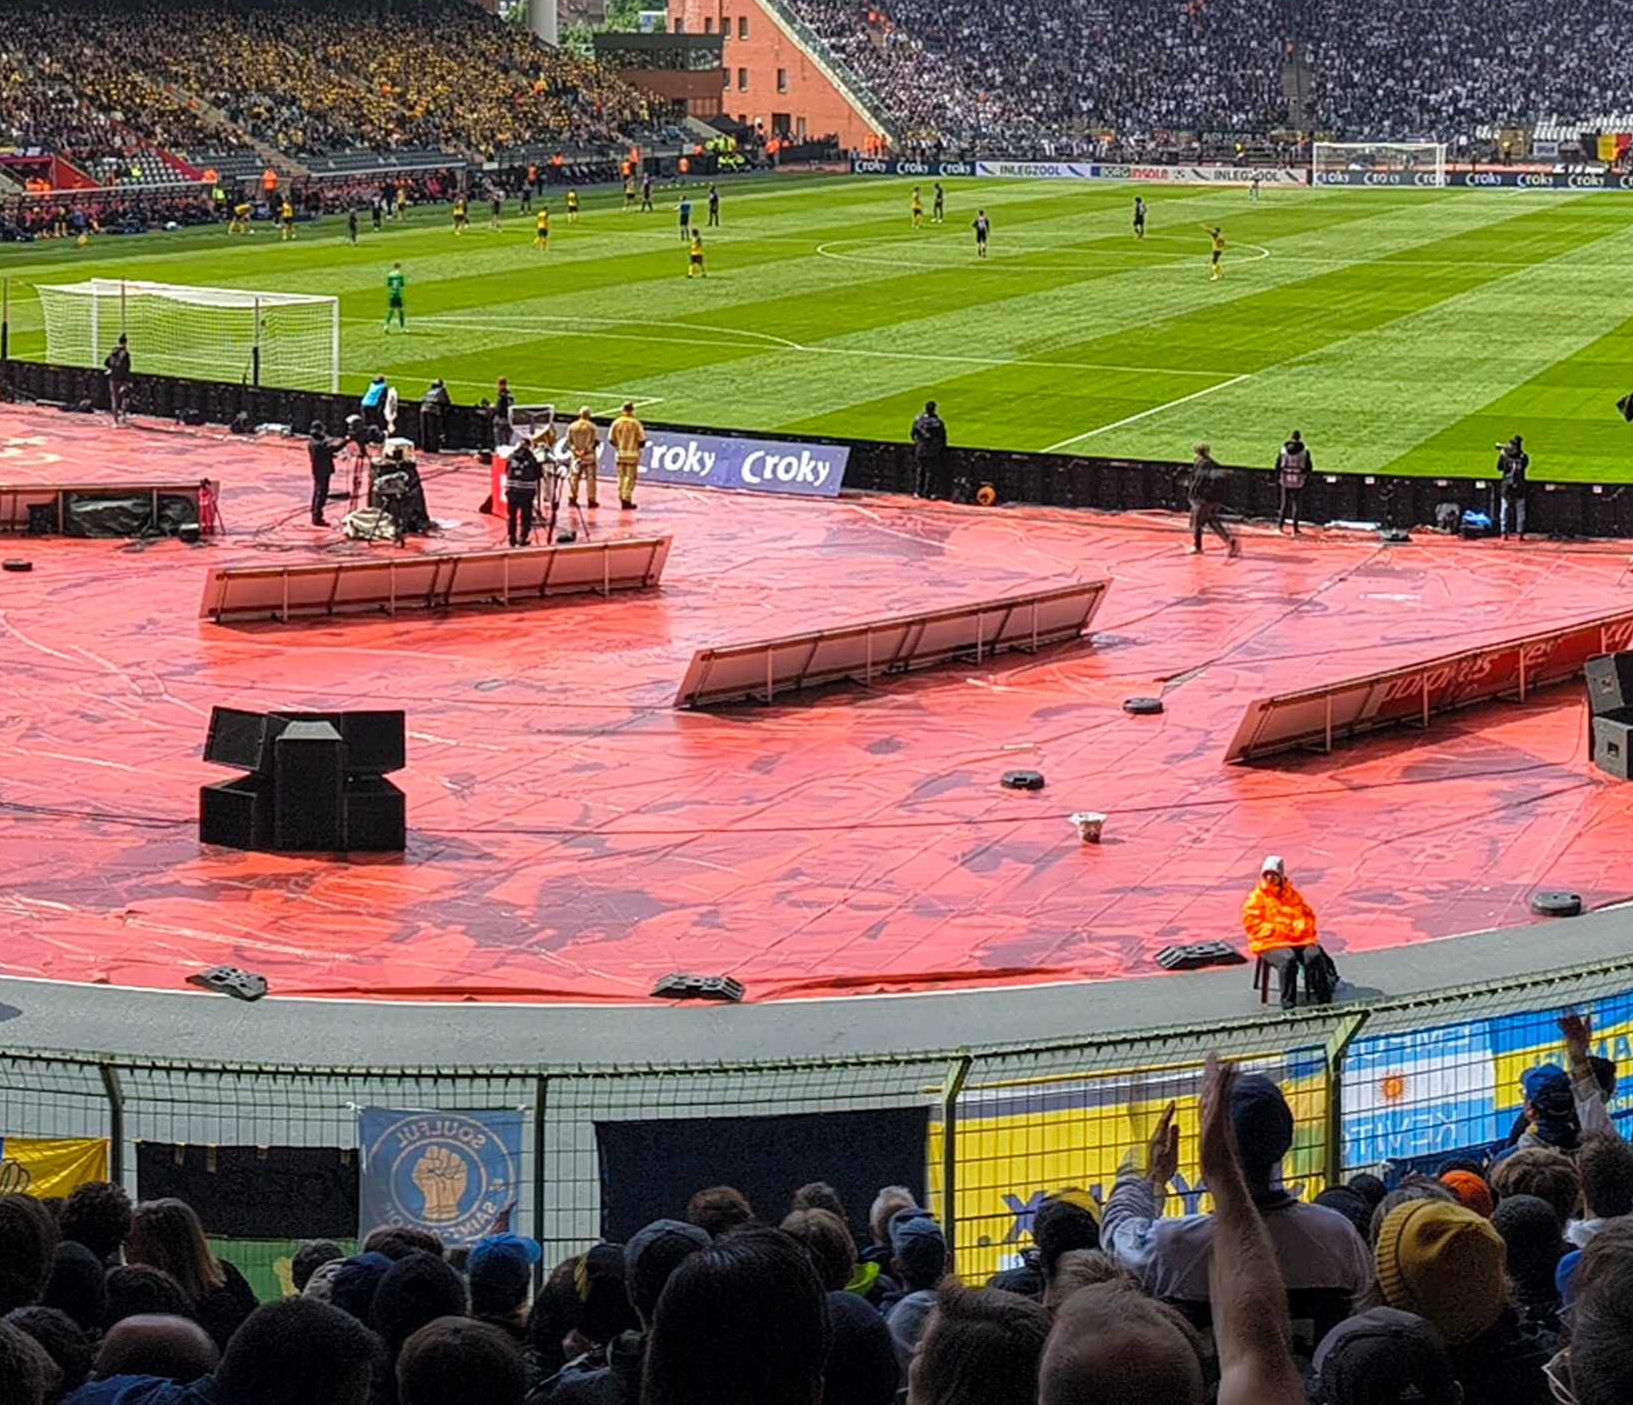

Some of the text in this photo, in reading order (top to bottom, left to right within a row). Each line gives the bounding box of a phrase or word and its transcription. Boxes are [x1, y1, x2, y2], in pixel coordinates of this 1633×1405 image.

[854, 160, 887, 175] Croky
[896, 161, 929, 176] Croky
[939, 161, 972, 176] Croky
[999, 164, 1062, 177] INLEGZOOL
[1465, 172, 1502, 186] Croky
[1517, 173, 1554, 187] Croky
[1568, 173, 1605, 188] Croky
[741, 450, 831, 486] Croky
